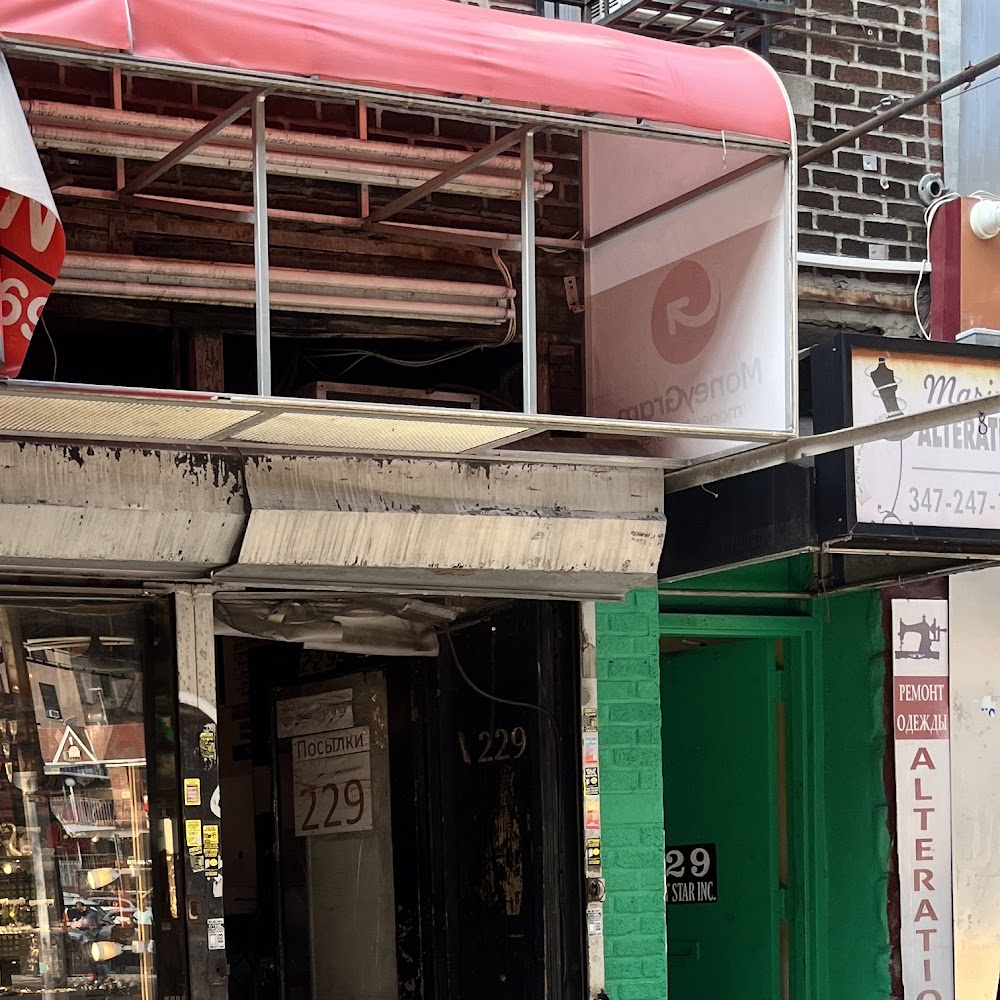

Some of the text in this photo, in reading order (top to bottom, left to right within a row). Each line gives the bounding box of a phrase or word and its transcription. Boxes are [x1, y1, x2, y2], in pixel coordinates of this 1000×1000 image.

[917, 416, 1000, 452] ALTERAT
[908, 486, 1000, 516] 347-247-
[898, 683, 945, 702] РЕМОНТ
[896, 713, 948, 736] ОДЕЖДЫ
[297, 733, 365, 759] Посылки
[477, 726, 527, 763] 229
[300, 778, 365, 832] 229
[671, 881, 696, 903] STAR
[696, 880, 717, 902] INC.
